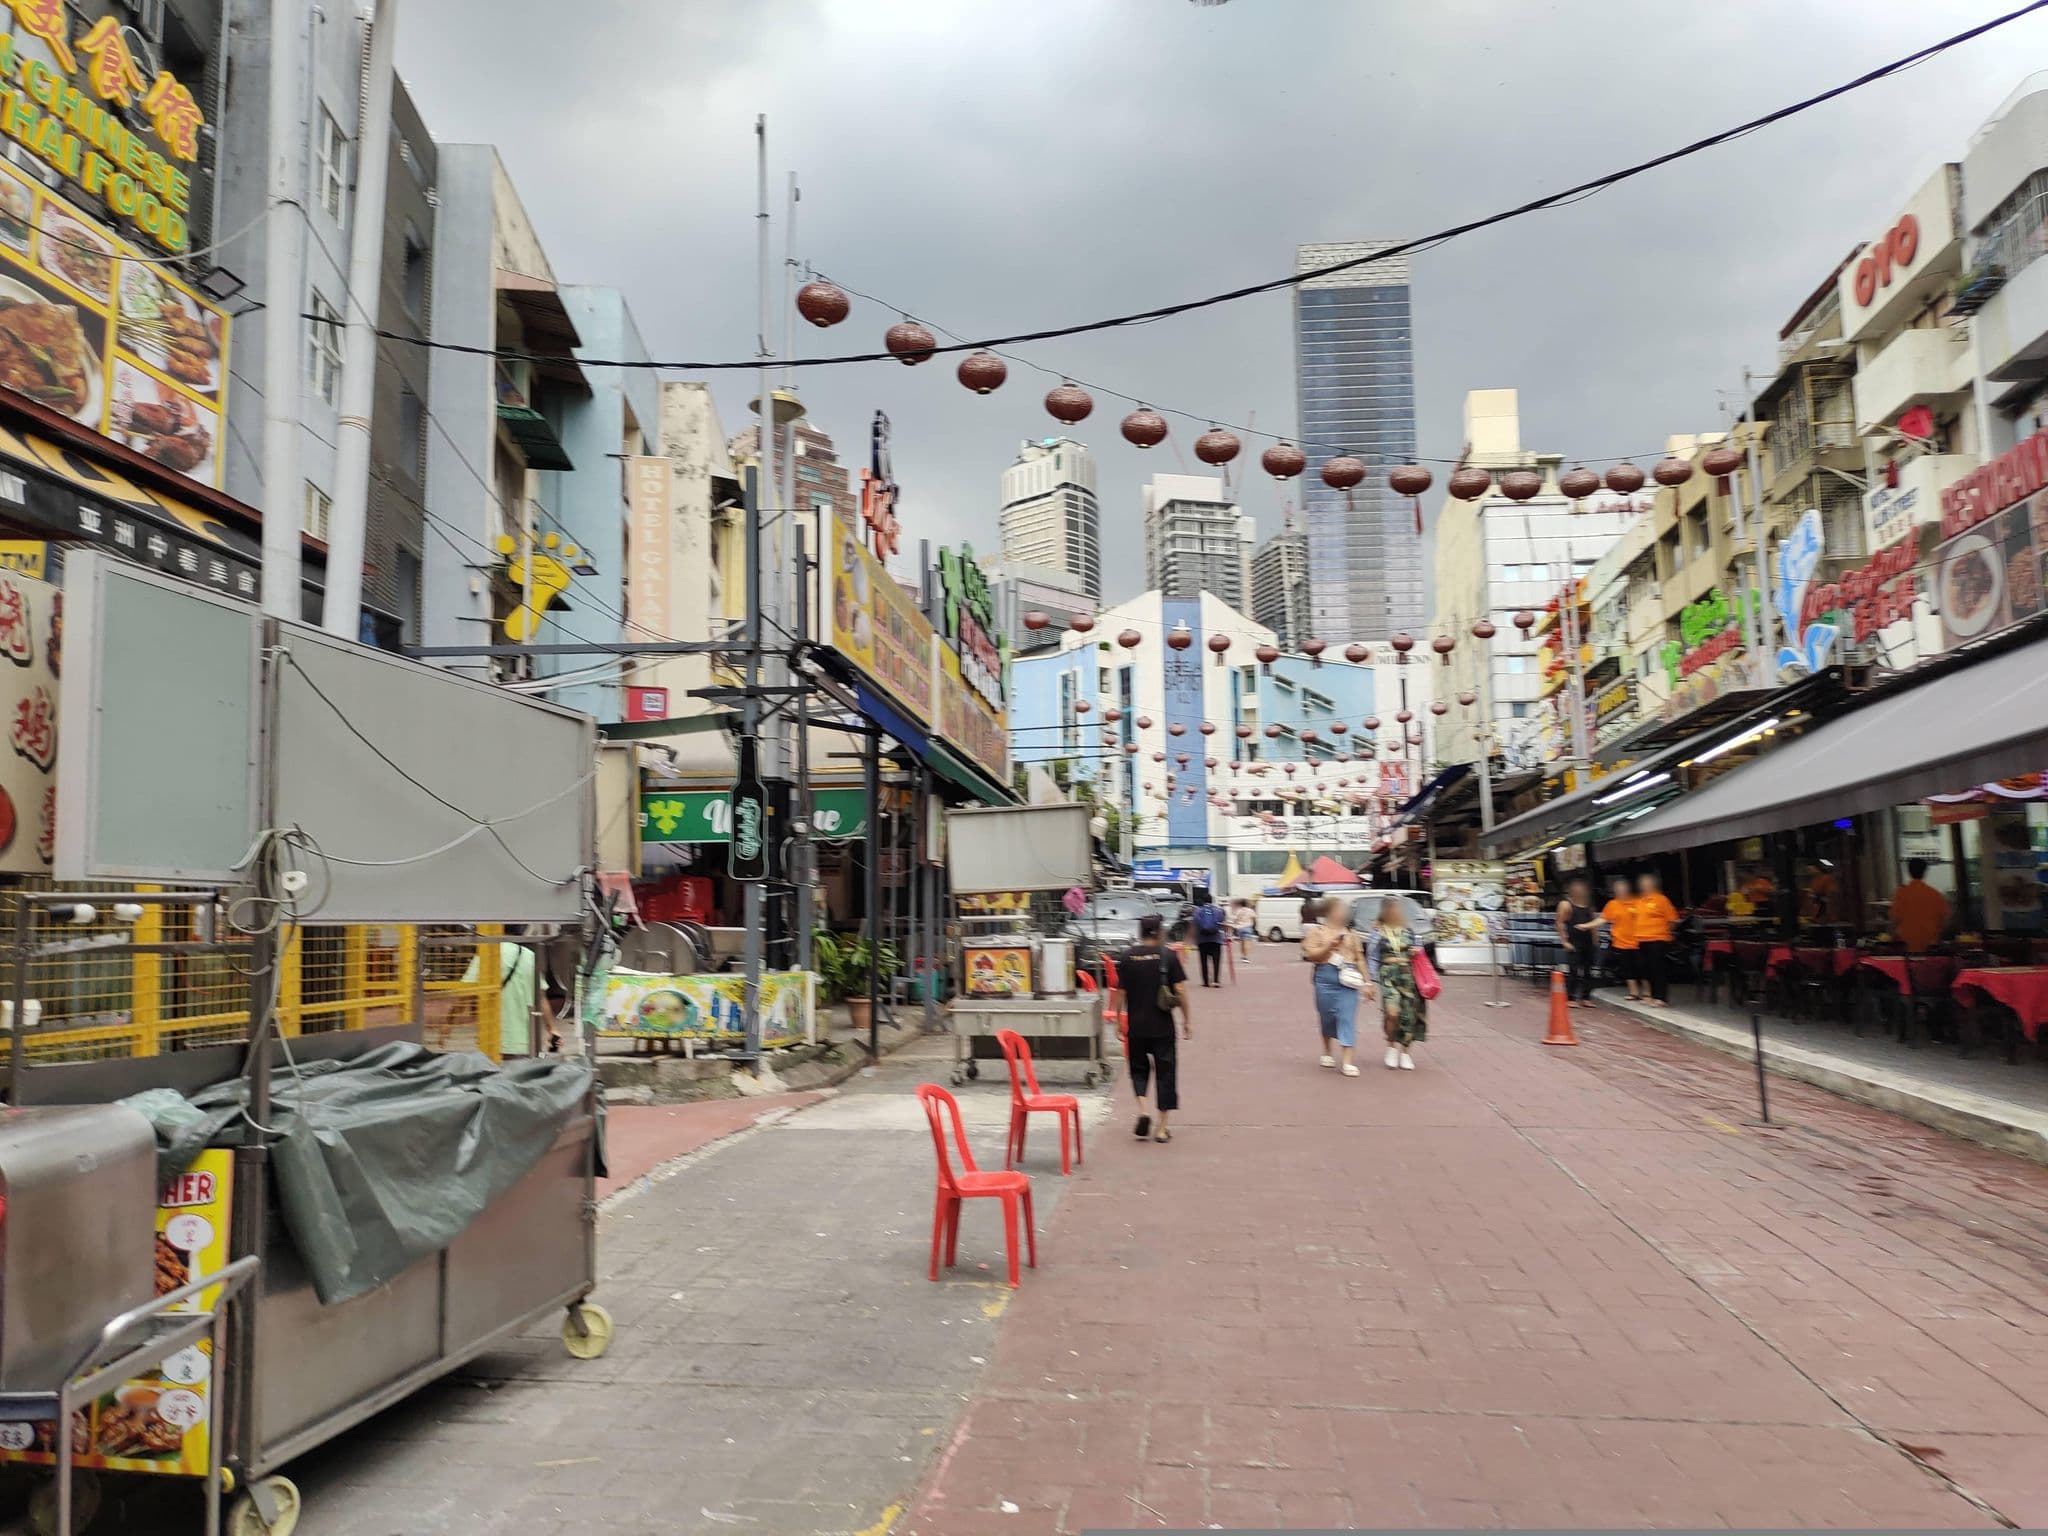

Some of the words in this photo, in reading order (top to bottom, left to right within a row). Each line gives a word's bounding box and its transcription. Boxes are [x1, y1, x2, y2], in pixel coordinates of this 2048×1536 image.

[22, 59, 190, 213] CHINESE
[82, 151, 189, 251] FOOD
[1855, 213, 1918, 307] OYO
[78, 505, 257, 594] 亚洲中泰美食
[639, 465, 664, 544] HOTEL
